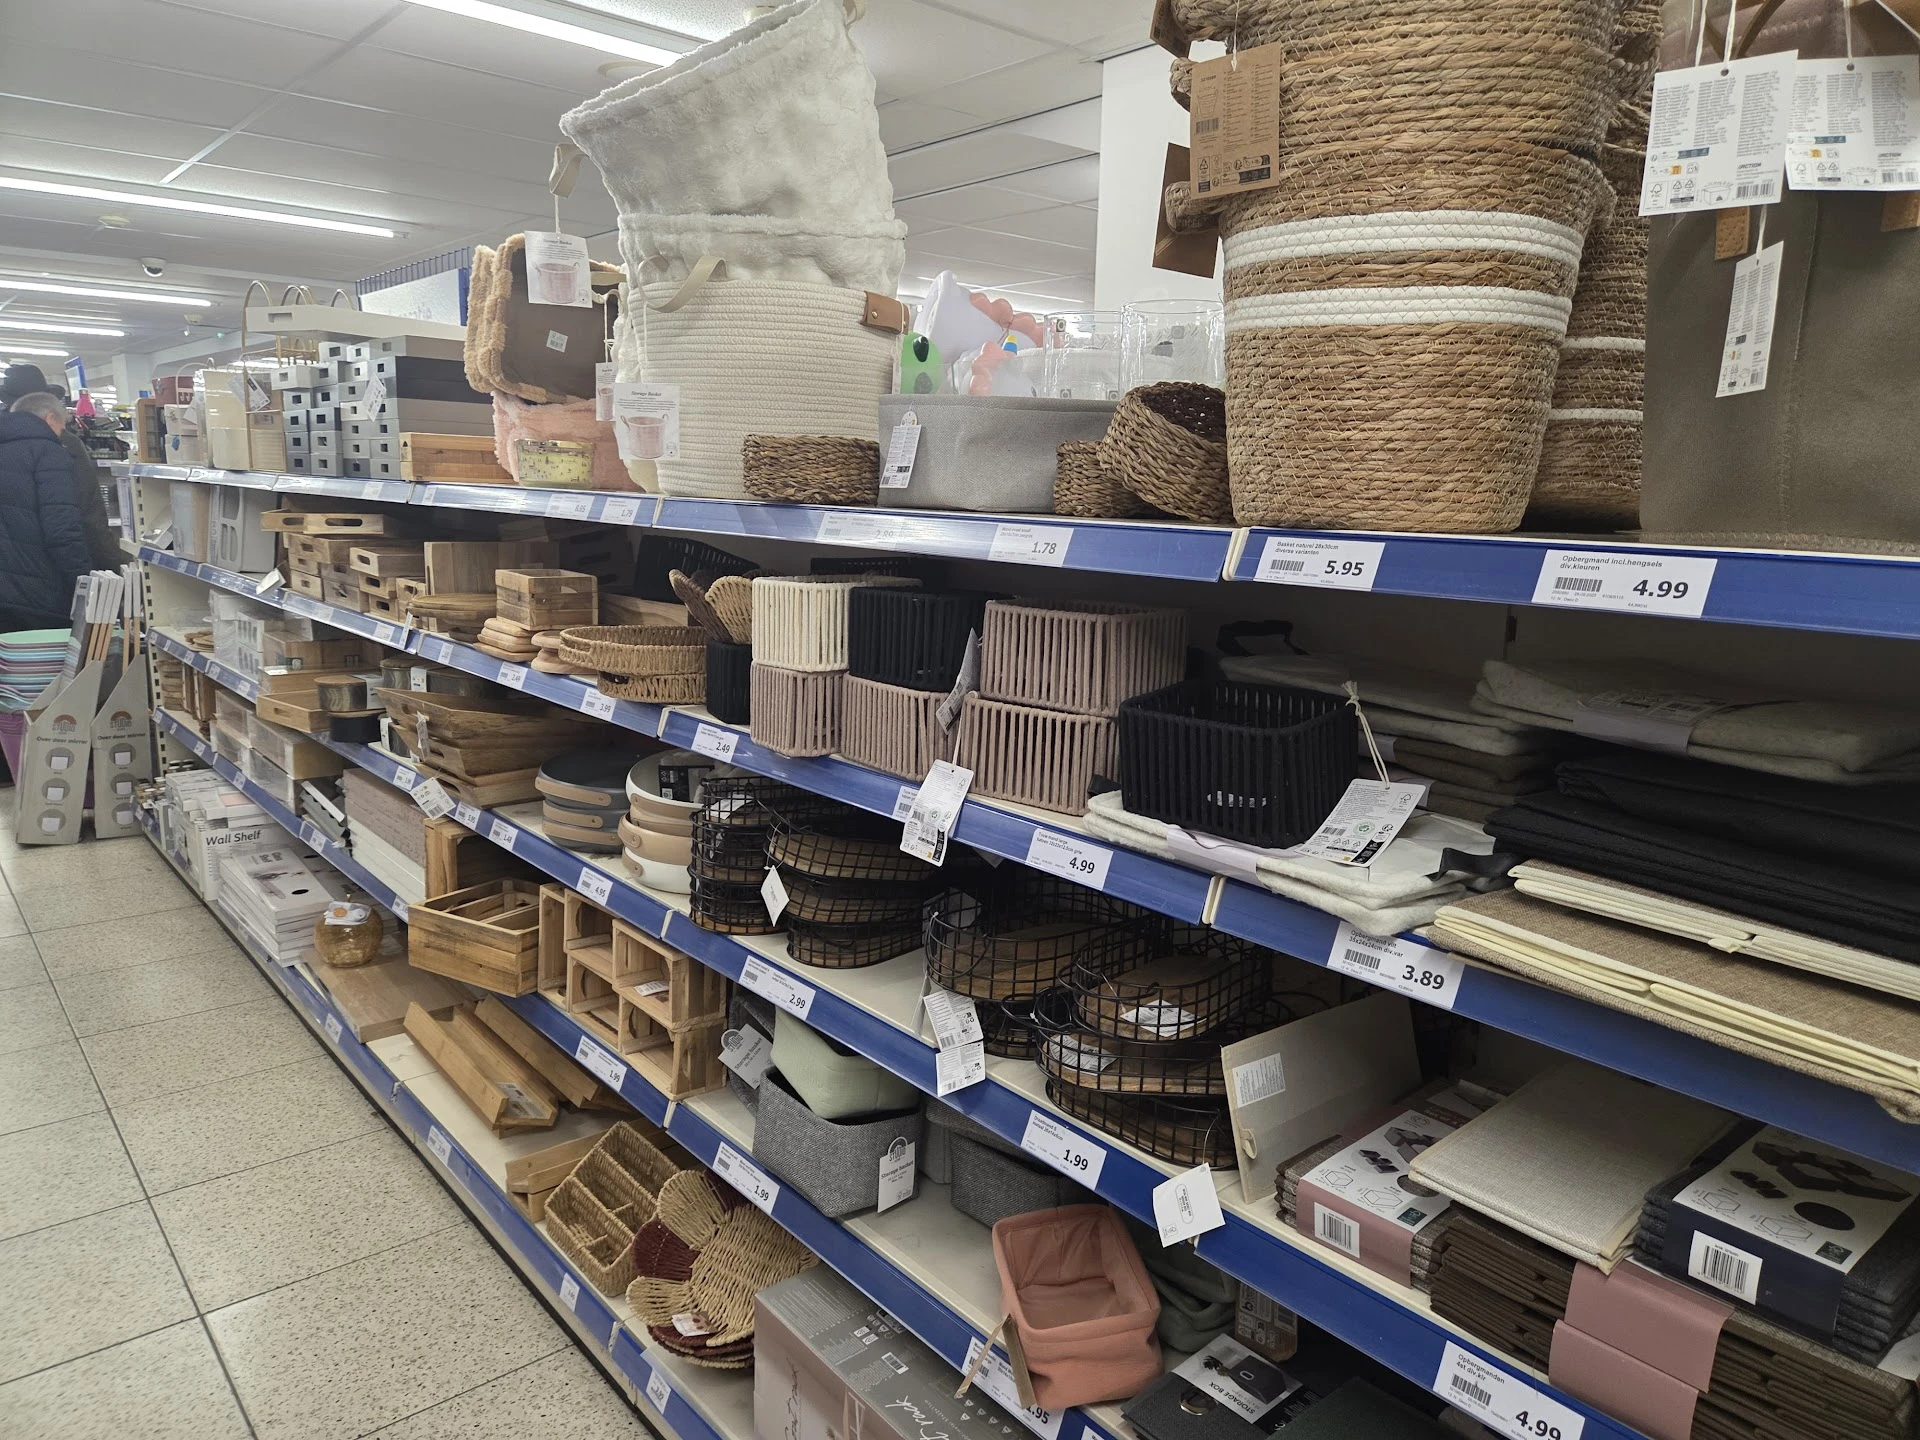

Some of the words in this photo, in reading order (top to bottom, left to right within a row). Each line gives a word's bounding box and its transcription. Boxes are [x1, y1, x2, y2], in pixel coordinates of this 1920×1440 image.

[1031, 541, 1057, 554] 1.78
[1324, 560, 1364, 576] 5.95
[1560, 563, 1600, 571] div.kleuren
[1562, 555, 1610, 564] Opbergmand
[1610, 558, 1663, 568] incl.hengsels
[1632, 579, 1689, 599] 4.99
[716, 742, 731, 753] 2.49
[206, 833, 231, 846] Wall
[233, 829, 262, 843] Shelf
[1069, 857, 1095, 874] 4.99
[595, 886, 606, 898] 4.95
[1351, 929, 1387, 946] Opbergmand
[1387, 940, 1397, 949] vilt
[1383, 947, 1404, 958] div.var
[1402, 965, 1445, 990] 3.89
[789, 993, 806, 1009] 2.99
[734, 1052, 751, 1070] Storage
[748, 1037, 763, 1053] basket
[1063, 1149, 1088, 1171] 1.99
[881, 1168, 899, 1180] Storage
[899, 1160, 914, 1171] basket
[754, 1185, 769, 1201] 1.99
[1456, 1361, 1467, 1372] 4st
[1466, 1365, 1487, 1382] div.klr
[1458, 1353, 1505, 1385] Opbergmanden
[1208, 1381, 1226, 1395] BOX
[1223, 1391, 1256, 1415] STORAGE
[1026, 1404, 1050, 1425] 1.95
[1515, 1410, 1561, 1440] 4.99
